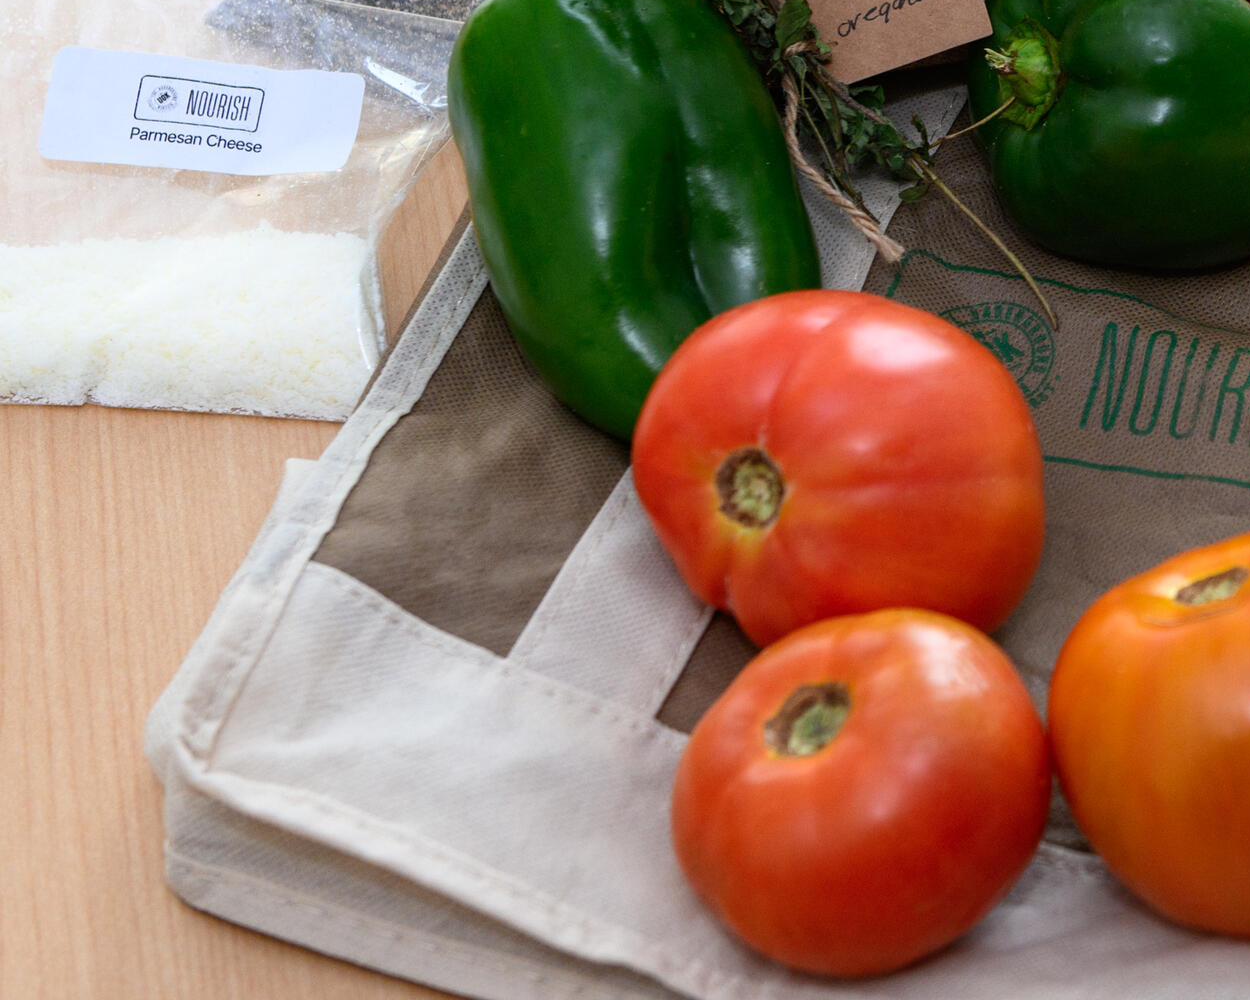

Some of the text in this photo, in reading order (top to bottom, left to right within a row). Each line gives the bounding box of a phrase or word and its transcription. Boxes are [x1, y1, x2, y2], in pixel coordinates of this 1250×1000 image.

[186, 89, 251, 121] NOURISH
[130, 127, 262, 154] Parmesan Cheese
